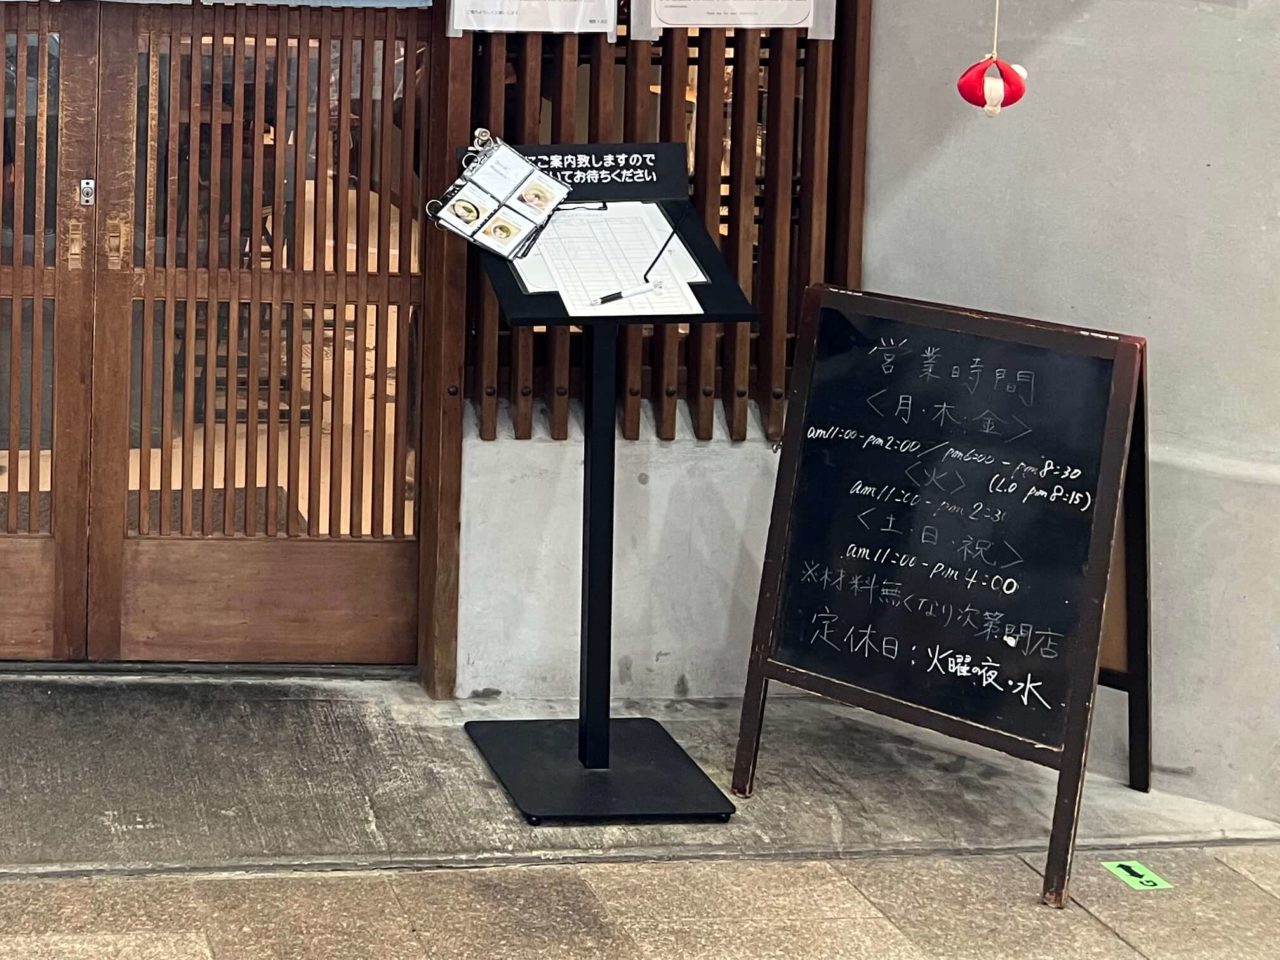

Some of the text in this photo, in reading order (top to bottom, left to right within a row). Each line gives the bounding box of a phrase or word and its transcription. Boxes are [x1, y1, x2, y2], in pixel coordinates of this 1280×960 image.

[543, 169, 657, 184] いてお待ちください
[869, 337, 1035, 407] 営業時間
